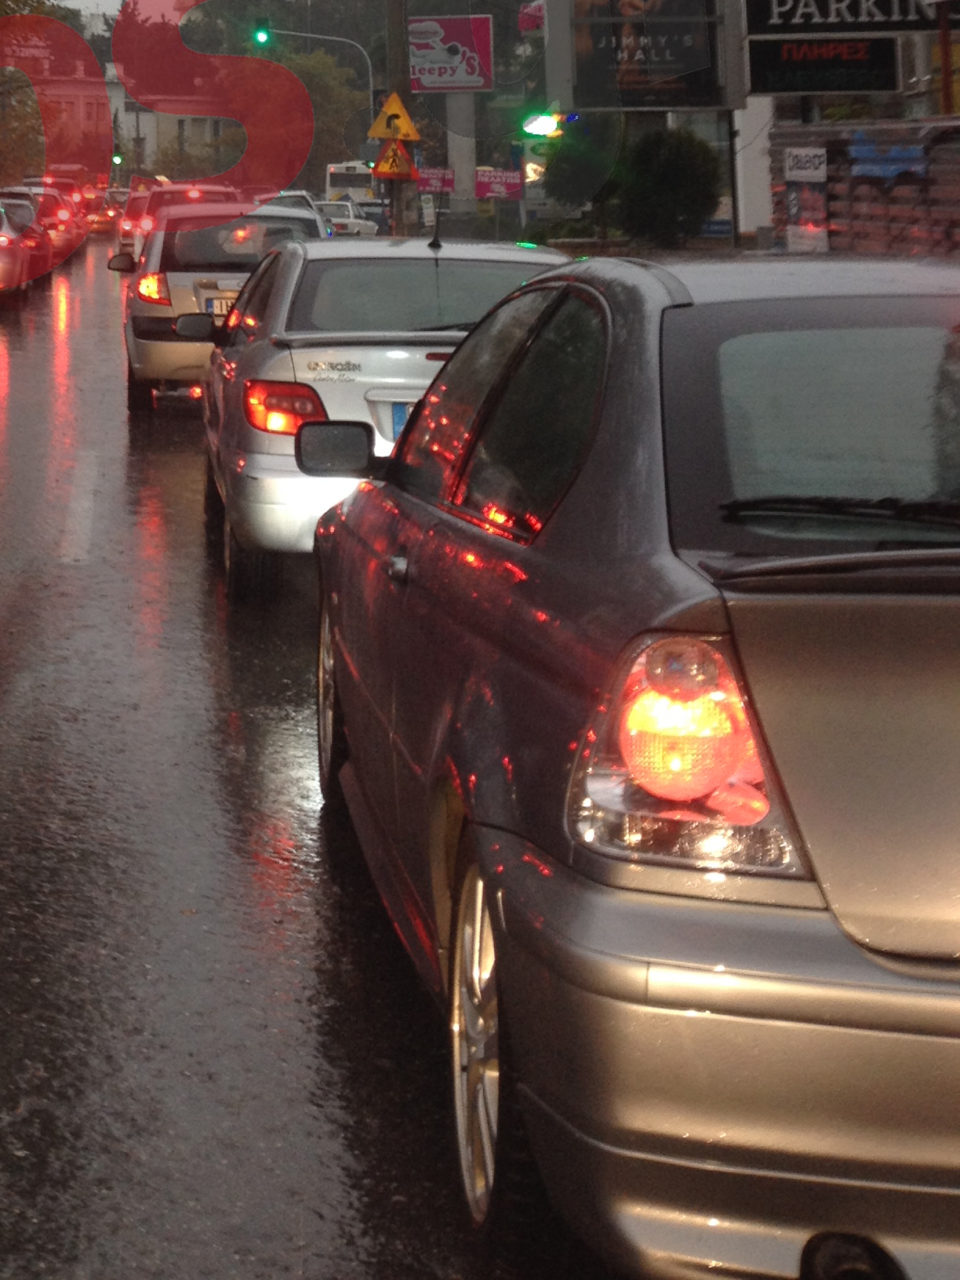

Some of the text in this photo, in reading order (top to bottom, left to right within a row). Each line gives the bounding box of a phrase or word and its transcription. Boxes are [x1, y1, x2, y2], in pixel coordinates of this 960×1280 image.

[597, 33, 693, 48] JIMMY'S
[616, 48, 677, 62] HALL
[781, 41, 870, 61] ΠΛΗΡΕΣ
[410, 48, 478, 77] leepy'S
[477, 170, 521, 178] PARKING
